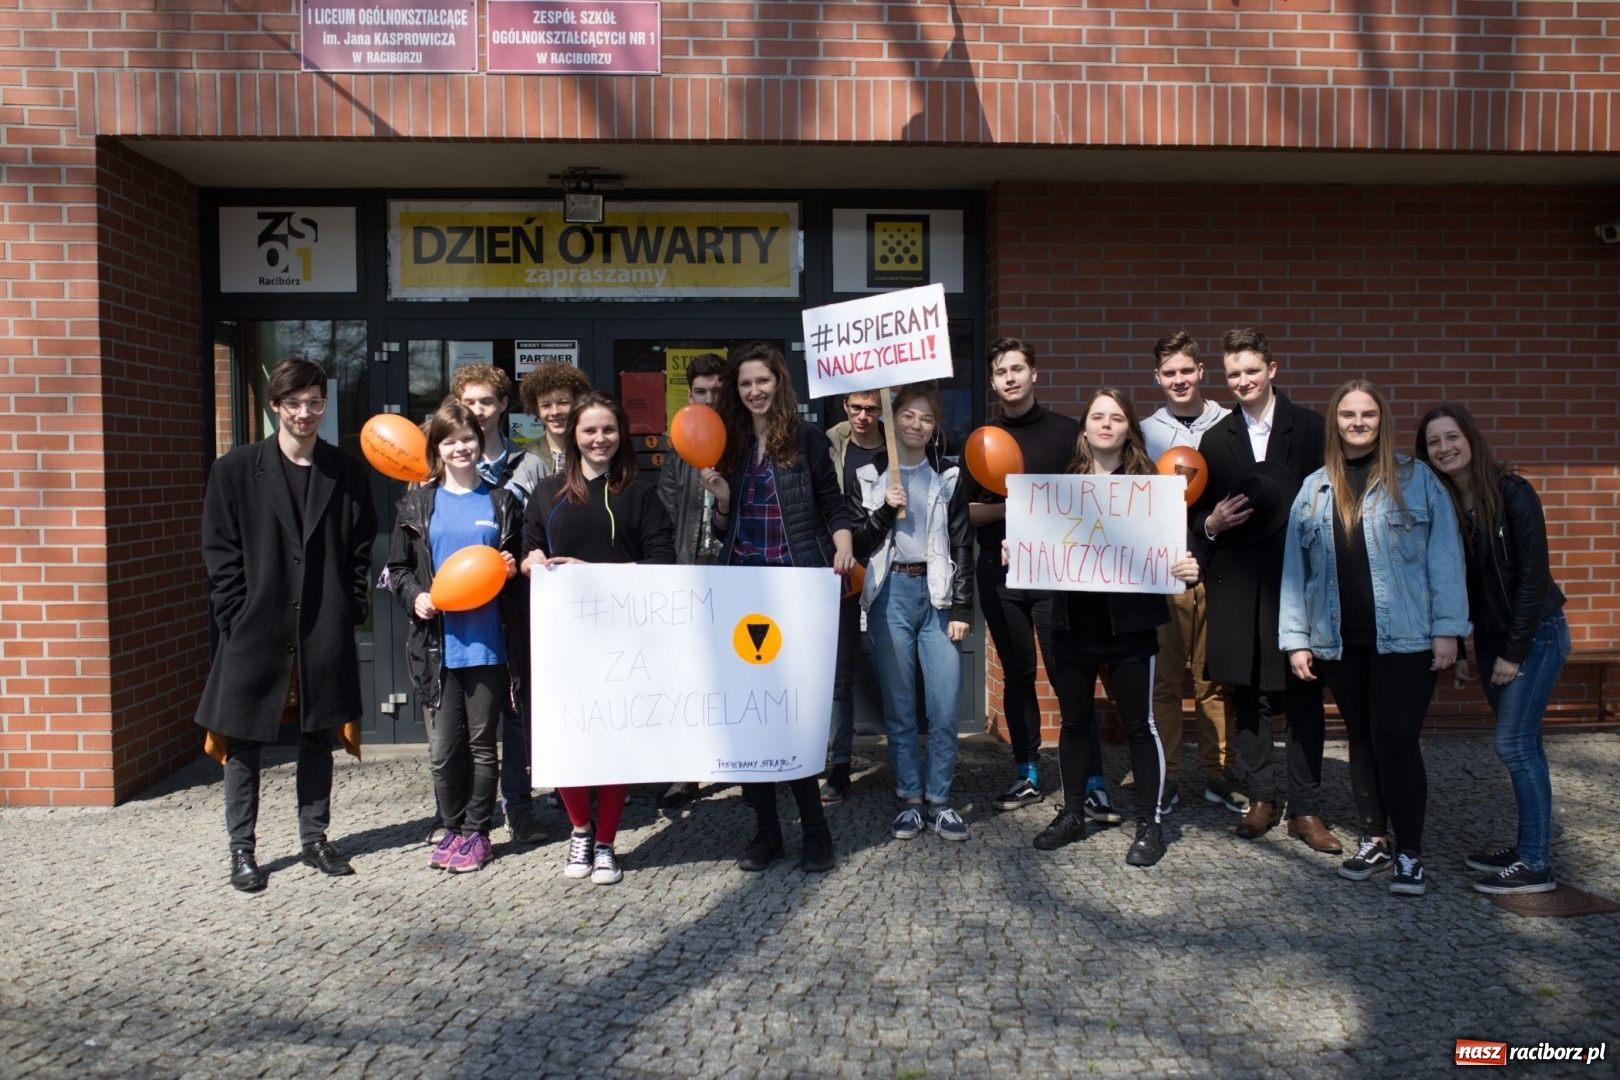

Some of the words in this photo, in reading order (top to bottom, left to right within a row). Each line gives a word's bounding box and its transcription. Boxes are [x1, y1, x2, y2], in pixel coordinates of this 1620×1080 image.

[307, 8, 313, 25] I
[315, 8, 356, 26] LICEUM
[358, 5, 468, 30] OGÓLNOKSZTAŁCĄCE
[533, 8, 577, 26] ZESPÓŁ
[580, 8, 617, 26] SZKÓŁ
[323, 31, 340, 46] im.
[344, 32, 370, 46] Jana
[374, 32, 456, 47] KASPROWICZA
[492, 28, 626, 48] OGÓLNOKSZTAŁCĄCYCH
[629, 32, 646, 45] NR
[649, 32, 655, 46] 1
[352, 52, 363, 64] W
[366, 52, 423, 64] RACIBORZU
[536, 52, 548, 65] W
[550, 52, 612, 65] RACIBORZU
[412, 217, 544, 265] DZIEŃ
[558, 225, 780, 265] OTWARTY
[259, 276, 301, 286] Racibórz
[525, 267, 668, 287] zapraszamy
[810, 303, 940, 353] #WSPIERAM
[817, 334, 937, 379] NAUCZYCIELI!
[1030, 480, 1153, 517] MUREM
[1061, 517, 1108, 545] ZA
[1016, 541, 1178, 587] NAUCZYCIELAMI
[571, 588, 715, 627] #MUREM
[604, 649, 651, 682] ZA
[562, 688, 798, 734] NAUCZYCIELAMI
